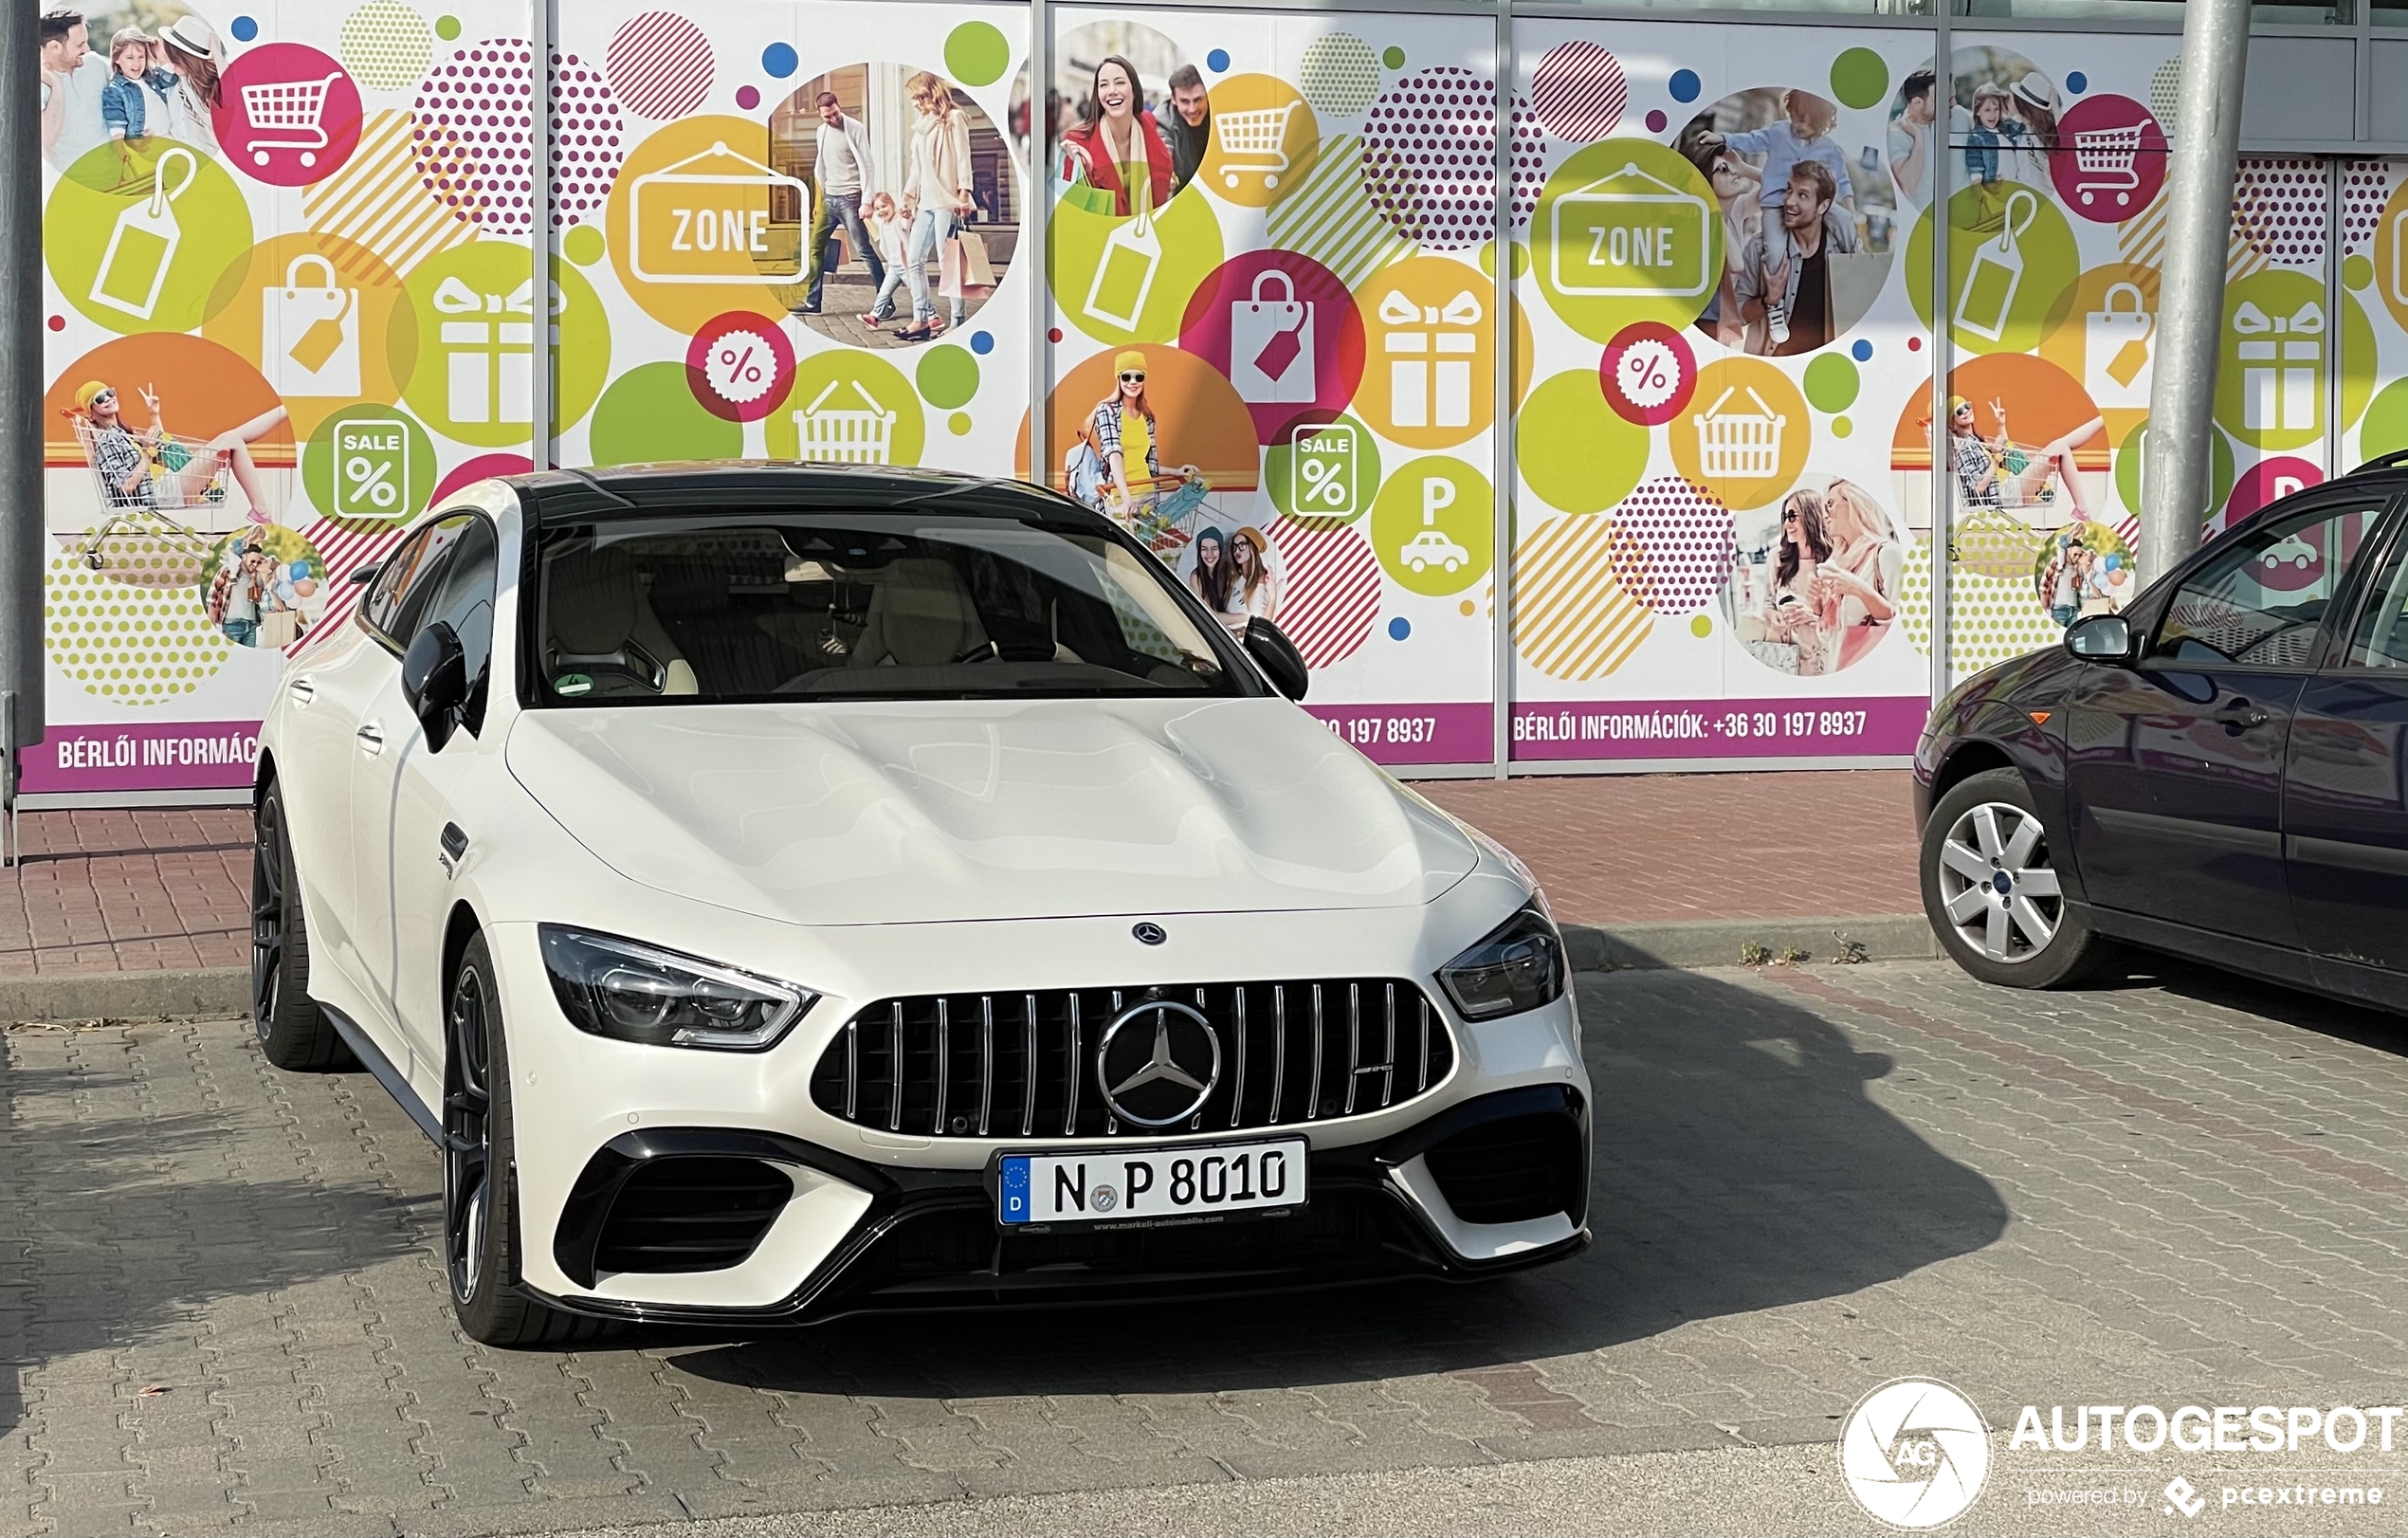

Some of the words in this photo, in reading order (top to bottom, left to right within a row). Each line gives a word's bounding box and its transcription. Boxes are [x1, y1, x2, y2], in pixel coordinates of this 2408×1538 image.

[671, 209, 769, 252] ZONE
[1588, 227, 1673, 266] ZONE
[343, 434, 400, 450] SALE
[1300, 438, 1349, 453] SALE
[1423, 476, 1456, 525] P
[1347, 718, 1382, 743] 197
[1387, 718, 1436, 743] 8937
[1513, 710, 1577, 742] BÉRLŐI
[1581, 708, 1709, 741] INFORMÁCIÓK:
[1713, 712, 1749, 738] +36
[1753, 712, 1777, 738] 30
[1783, 711, 1815, 737] 197
[1819, 710, 1867, 736] 8937
[58, 735, 137, 769] BÉRLŐI
[1054, 1163, 1085, 1213] N
[1123, 1161, 1154, 1209] P
[1169, 1150, 1286, 1206] 8010
[1010, 1196, 1022, 1212] D
